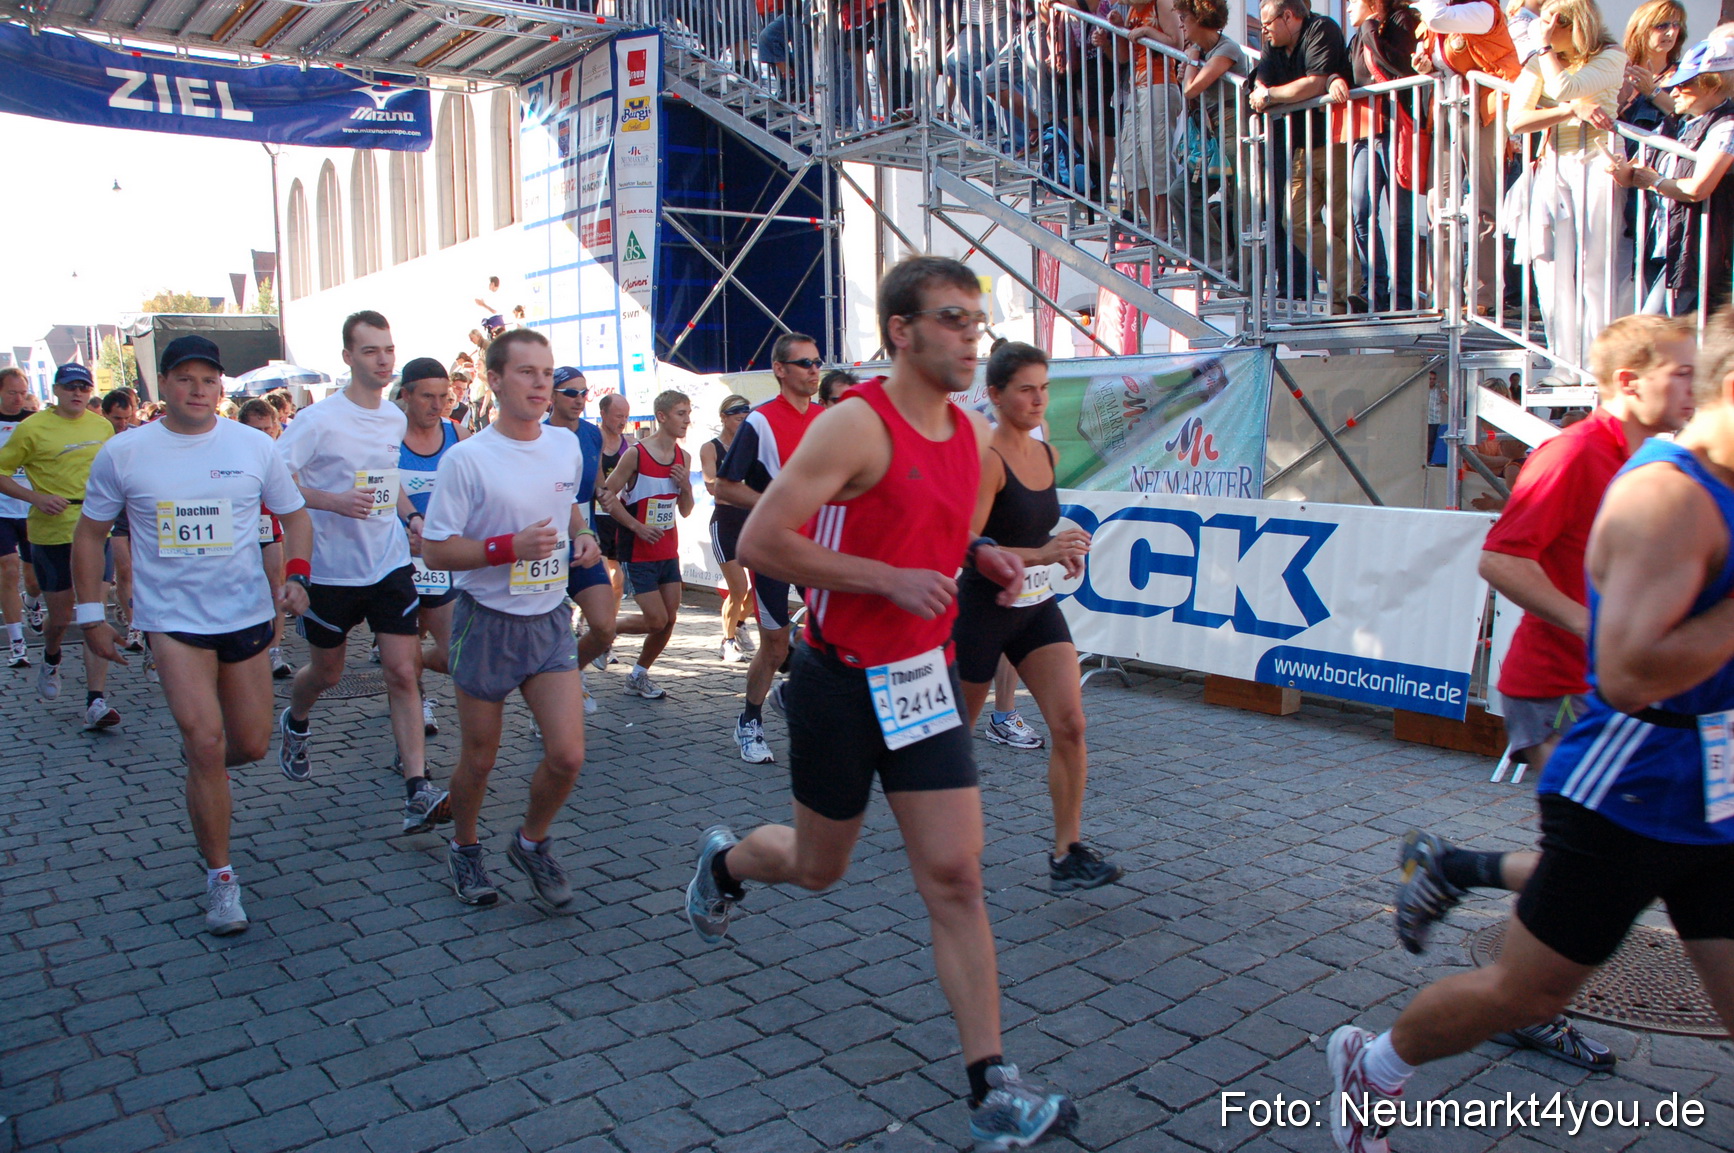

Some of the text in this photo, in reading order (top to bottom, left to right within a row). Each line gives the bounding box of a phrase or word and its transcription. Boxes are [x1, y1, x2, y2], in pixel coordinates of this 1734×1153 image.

[105, 67, 254, 122] ZIEL
[368, 475, 384, 485] Marc
[176, 506, 219, 517] Joachim
[656, 512, 673, 523] 589
[162, 522, 171, 532] A
[179, 523, 213, 541] 611
[531, 559, 559, 578] 613
[414, 570, 446, 584] 3463
[1274, 658, 1461, 705] www.bockonline.de
[895, 683, 947, 720] 2414
